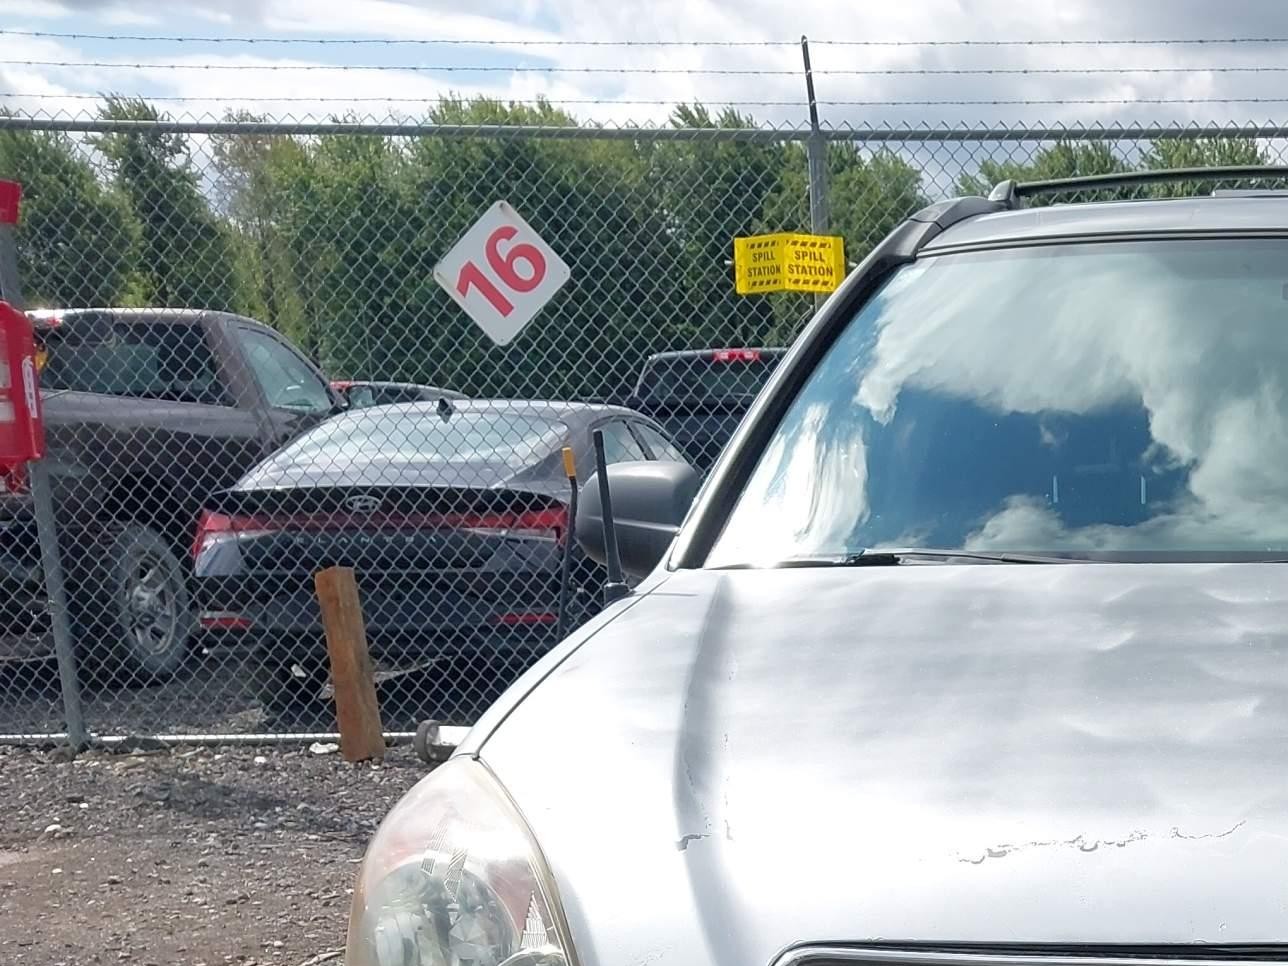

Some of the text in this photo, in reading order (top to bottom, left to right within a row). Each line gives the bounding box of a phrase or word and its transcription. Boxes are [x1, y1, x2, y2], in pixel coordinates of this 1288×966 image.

[752, 251, 776, 262] SPILL
[794, 250, 826, 262] SPILL
[456, 225, 546, 318] 16
[747, 264, 781, 277] STATION
[788, 264, 833, 276] STATION
